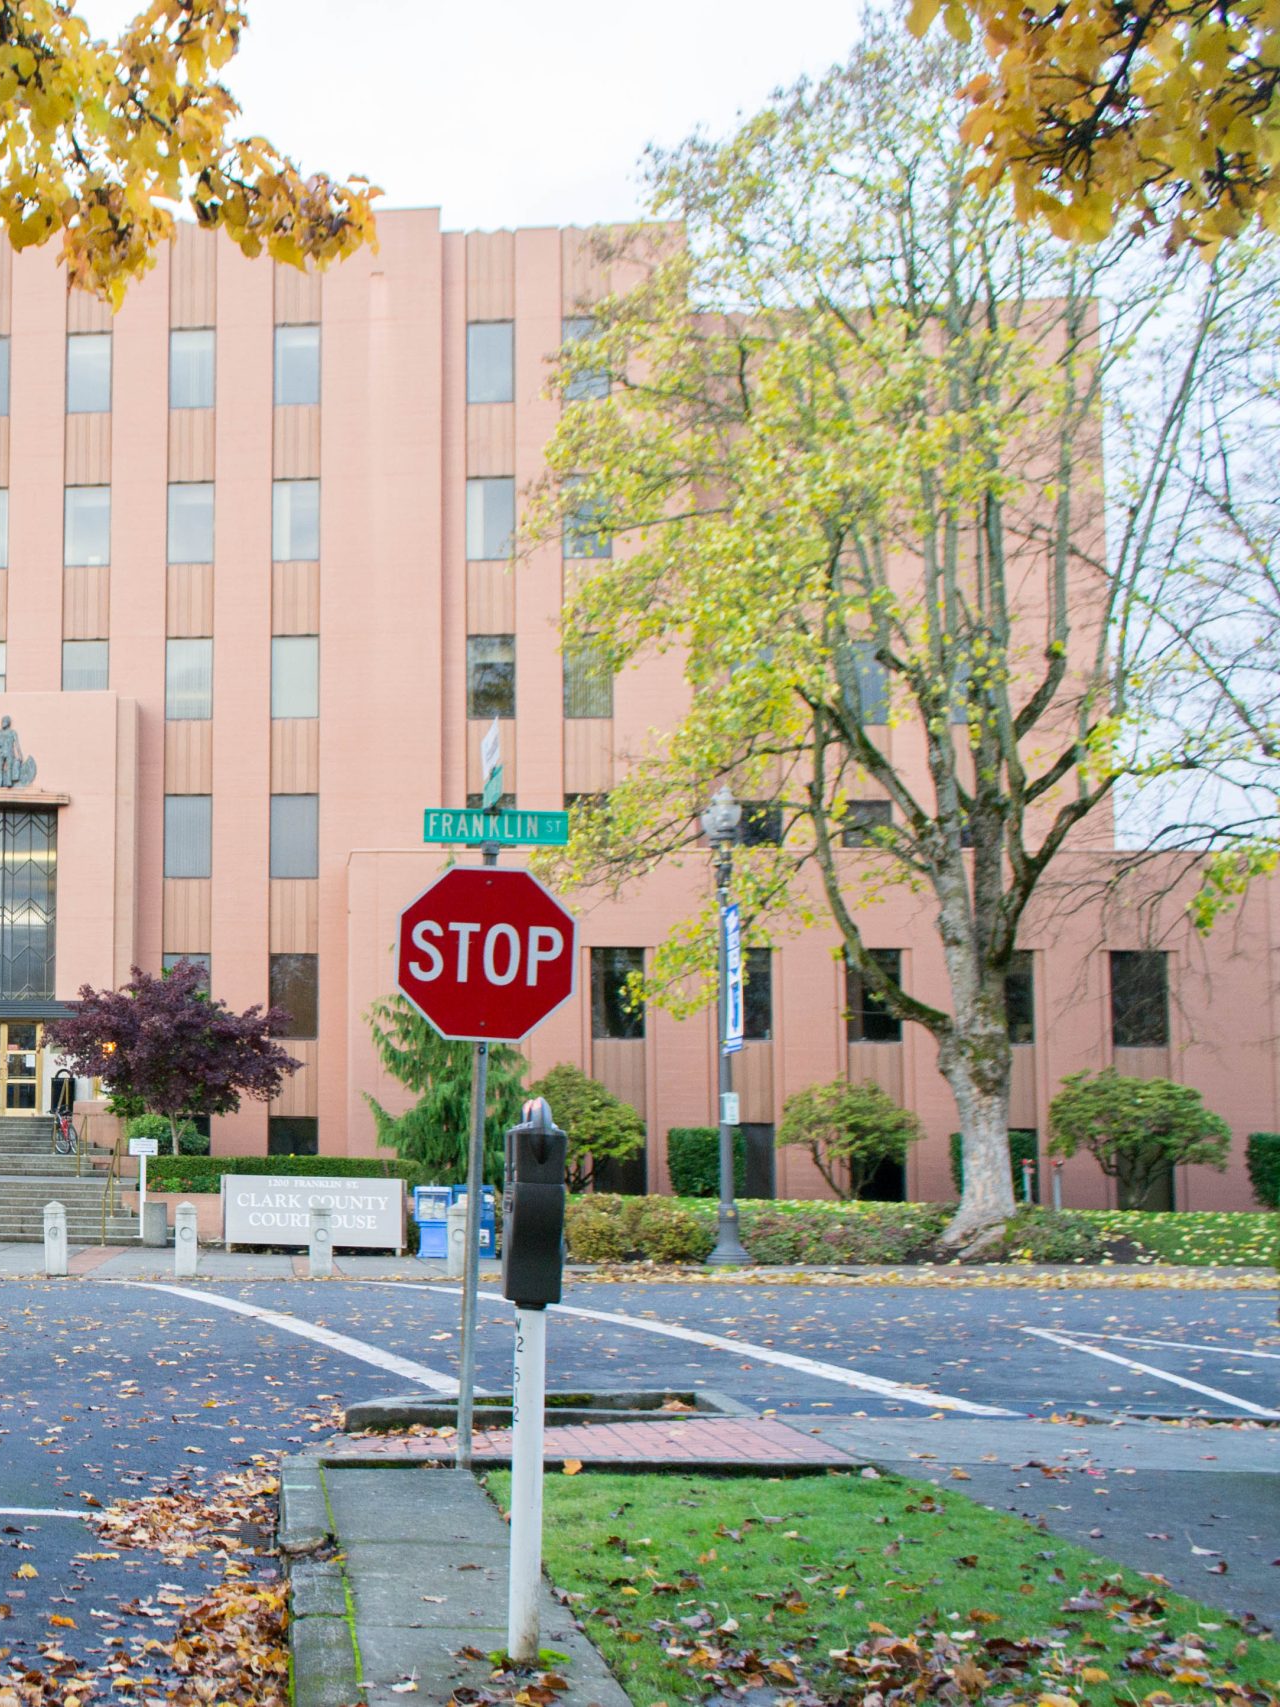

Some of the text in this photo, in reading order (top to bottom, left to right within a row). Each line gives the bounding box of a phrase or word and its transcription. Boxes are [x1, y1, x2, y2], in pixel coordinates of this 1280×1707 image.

[428, 813, 562, 838] FRANKLIN ST
[408, 919, 564, 987] STOP
[268, 1179, 289, 1187] 1200
[294, 1179, 342, 1189] FRANKLIN
[236, 1192, 389, 1210] CLARK COUNTY
[248, 1212, 378, 1229] COURTOUSE
